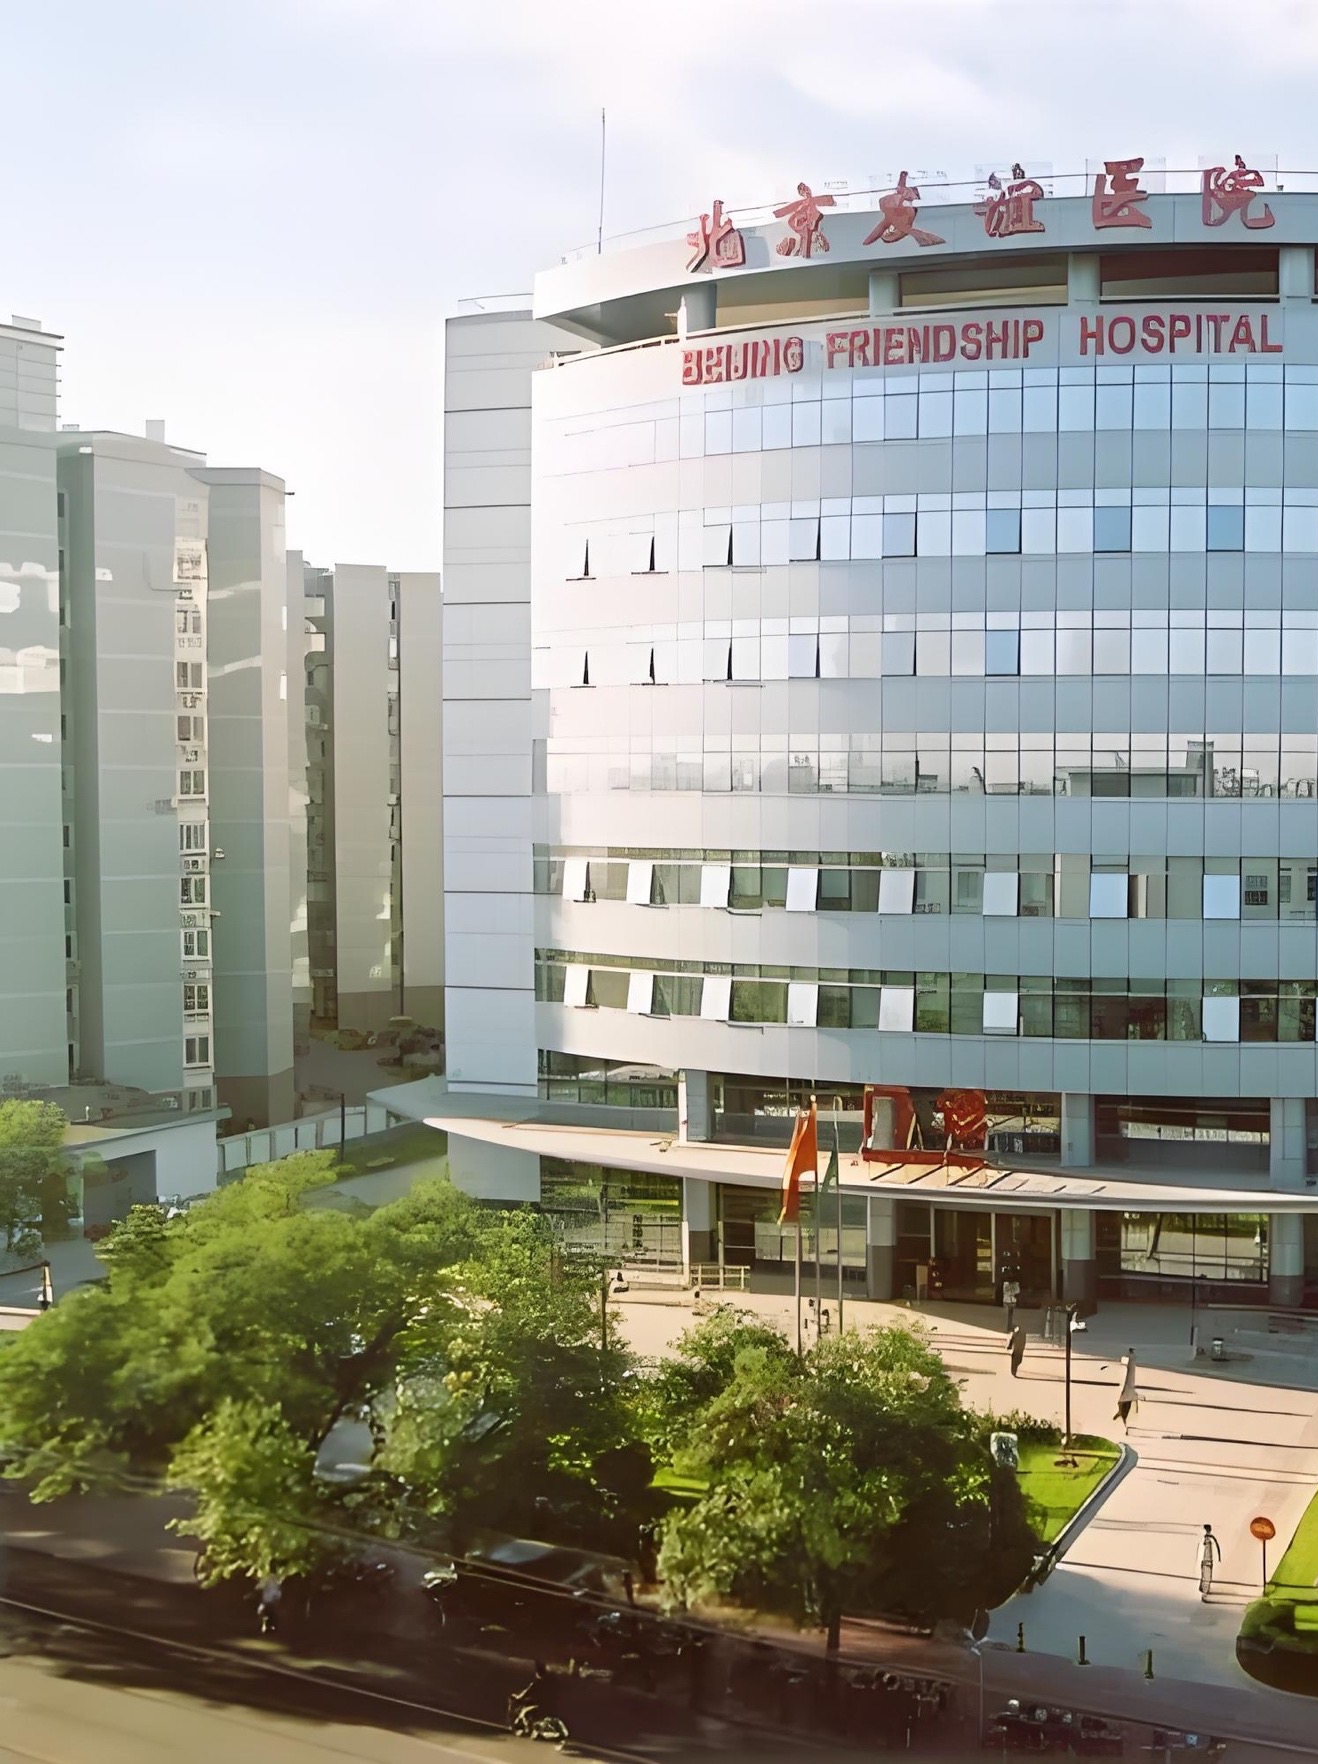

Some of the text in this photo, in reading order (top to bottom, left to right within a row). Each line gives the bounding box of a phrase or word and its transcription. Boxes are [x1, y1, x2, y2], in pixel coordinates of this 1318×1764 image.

[685, 155, 1276, 273] 北京友谊医院
[681, 313, 1284, 386] BEIJING FRIENDSHIP HOSPITAL
